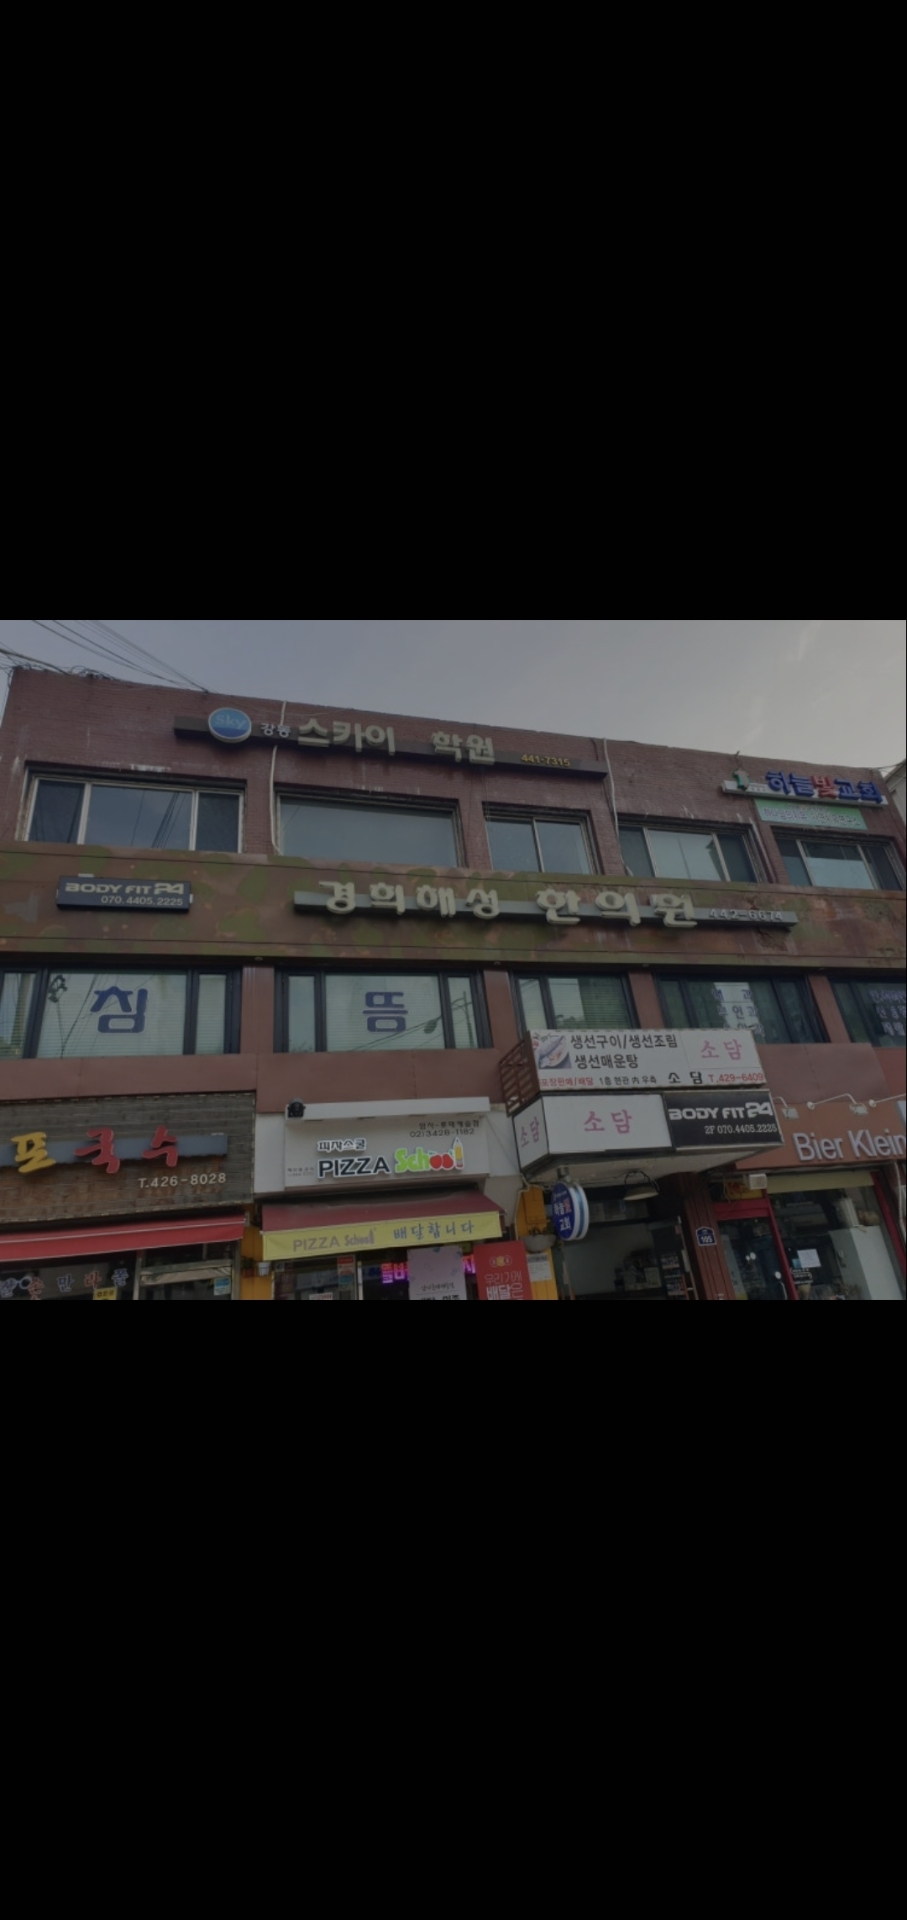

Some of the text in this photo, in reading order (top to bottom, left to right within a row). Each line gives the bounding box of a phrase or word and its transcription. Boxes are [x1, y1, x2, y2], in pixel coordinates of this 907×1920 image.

[215, 714, 246, 730] Sky
[260, 718, 571, 767] 강동 스카이 학원 441-7315
[766, 770, 882, 804] 하늘빛교회
[65, 882, 122, 894] BODY
[125, 885, 151, 895] FIT
[101, 895, 183, 906] 070.4405.2225
[319, 880, 500, 920] 경희해성
[535, 888, 698, 926] 한의원
[90, 986, 148, 1034] 침
[363, 991, 408, 1034] 뜸
[570, 1034, 678, 1049] 생선구이/생선조림
[701, 1039, 742, 1060] 소담
[574, 1053, 638, 1070] 생선매운탕
[708, 1073, 764, 1084] T.429-6409
[668, 1102, 773, 1120] BODY FIT 24
[584, 1109, 632, 1134] 소담
[705, 1123, 777, 1135] 2F 070.4405.2225
[318, 1138, 366, 1152] 피자스쿨
[793, 1128, 906, 1161] Bier Klein
[318, 1157, 390, 1178] PIZZA
[394, 1138, 464, 1174] School
[138, 1173, 227, 1189] T.426-8028
[293, 1235, 341, 1252] PIZZA
[393, 1219, 475, 1241] 배달합니다
[701, 1235, 713, 1243] 105
